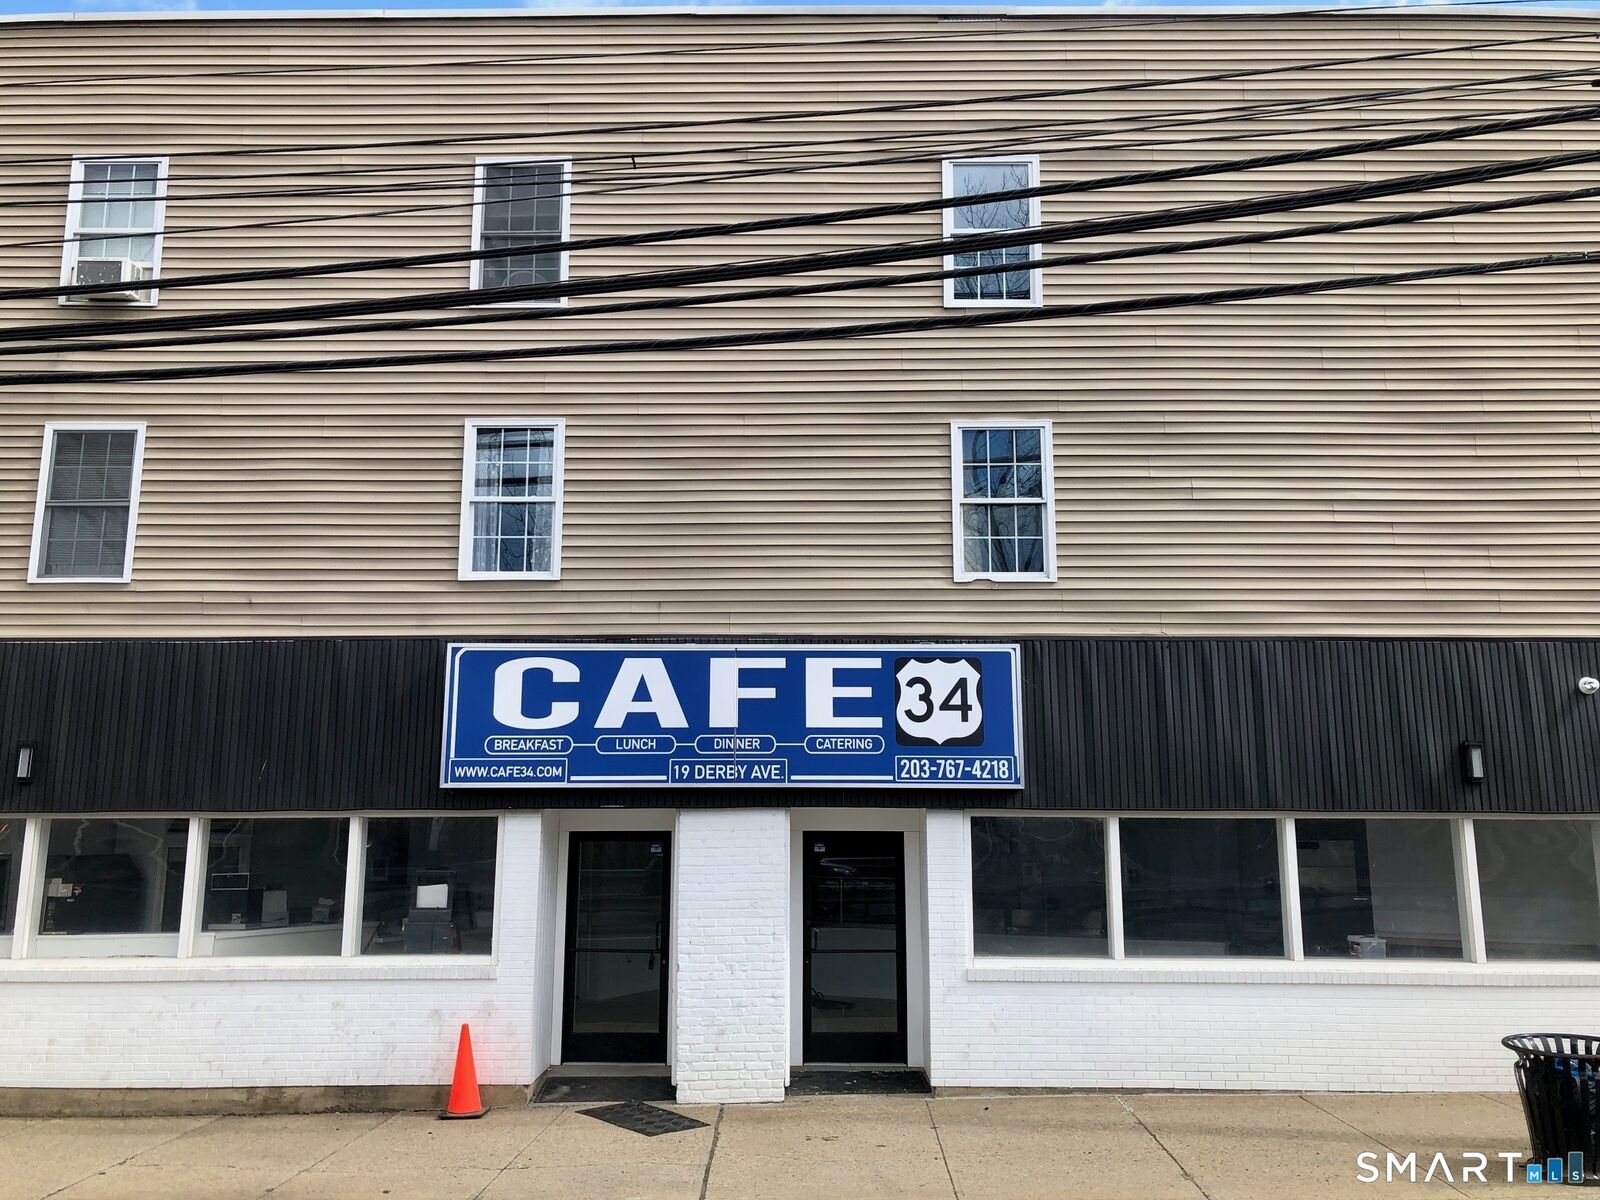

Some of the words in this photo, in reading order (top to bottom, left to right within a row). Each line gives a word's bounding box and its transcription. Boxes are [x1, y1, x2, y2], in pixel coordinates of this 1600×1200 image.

[493, 656, 883, 730] CAFE
[904, 676, 973, 723] 34
[494, 739, 564, 751] BREAKFAST
[615, 738, 657, 750] LUNCH
[713, 738, 761, 750] DINNER
[816, 738, 873, 750] CATERING
[454, 765, 563, 778] WWW.CAFE34.COM
[673, 764, 690, 780] 19
[694, 764, 748, 780] DERBY
[751, 764, 785, 780] AVE.
[900, 758, 1009, 779] 203-767-4218
